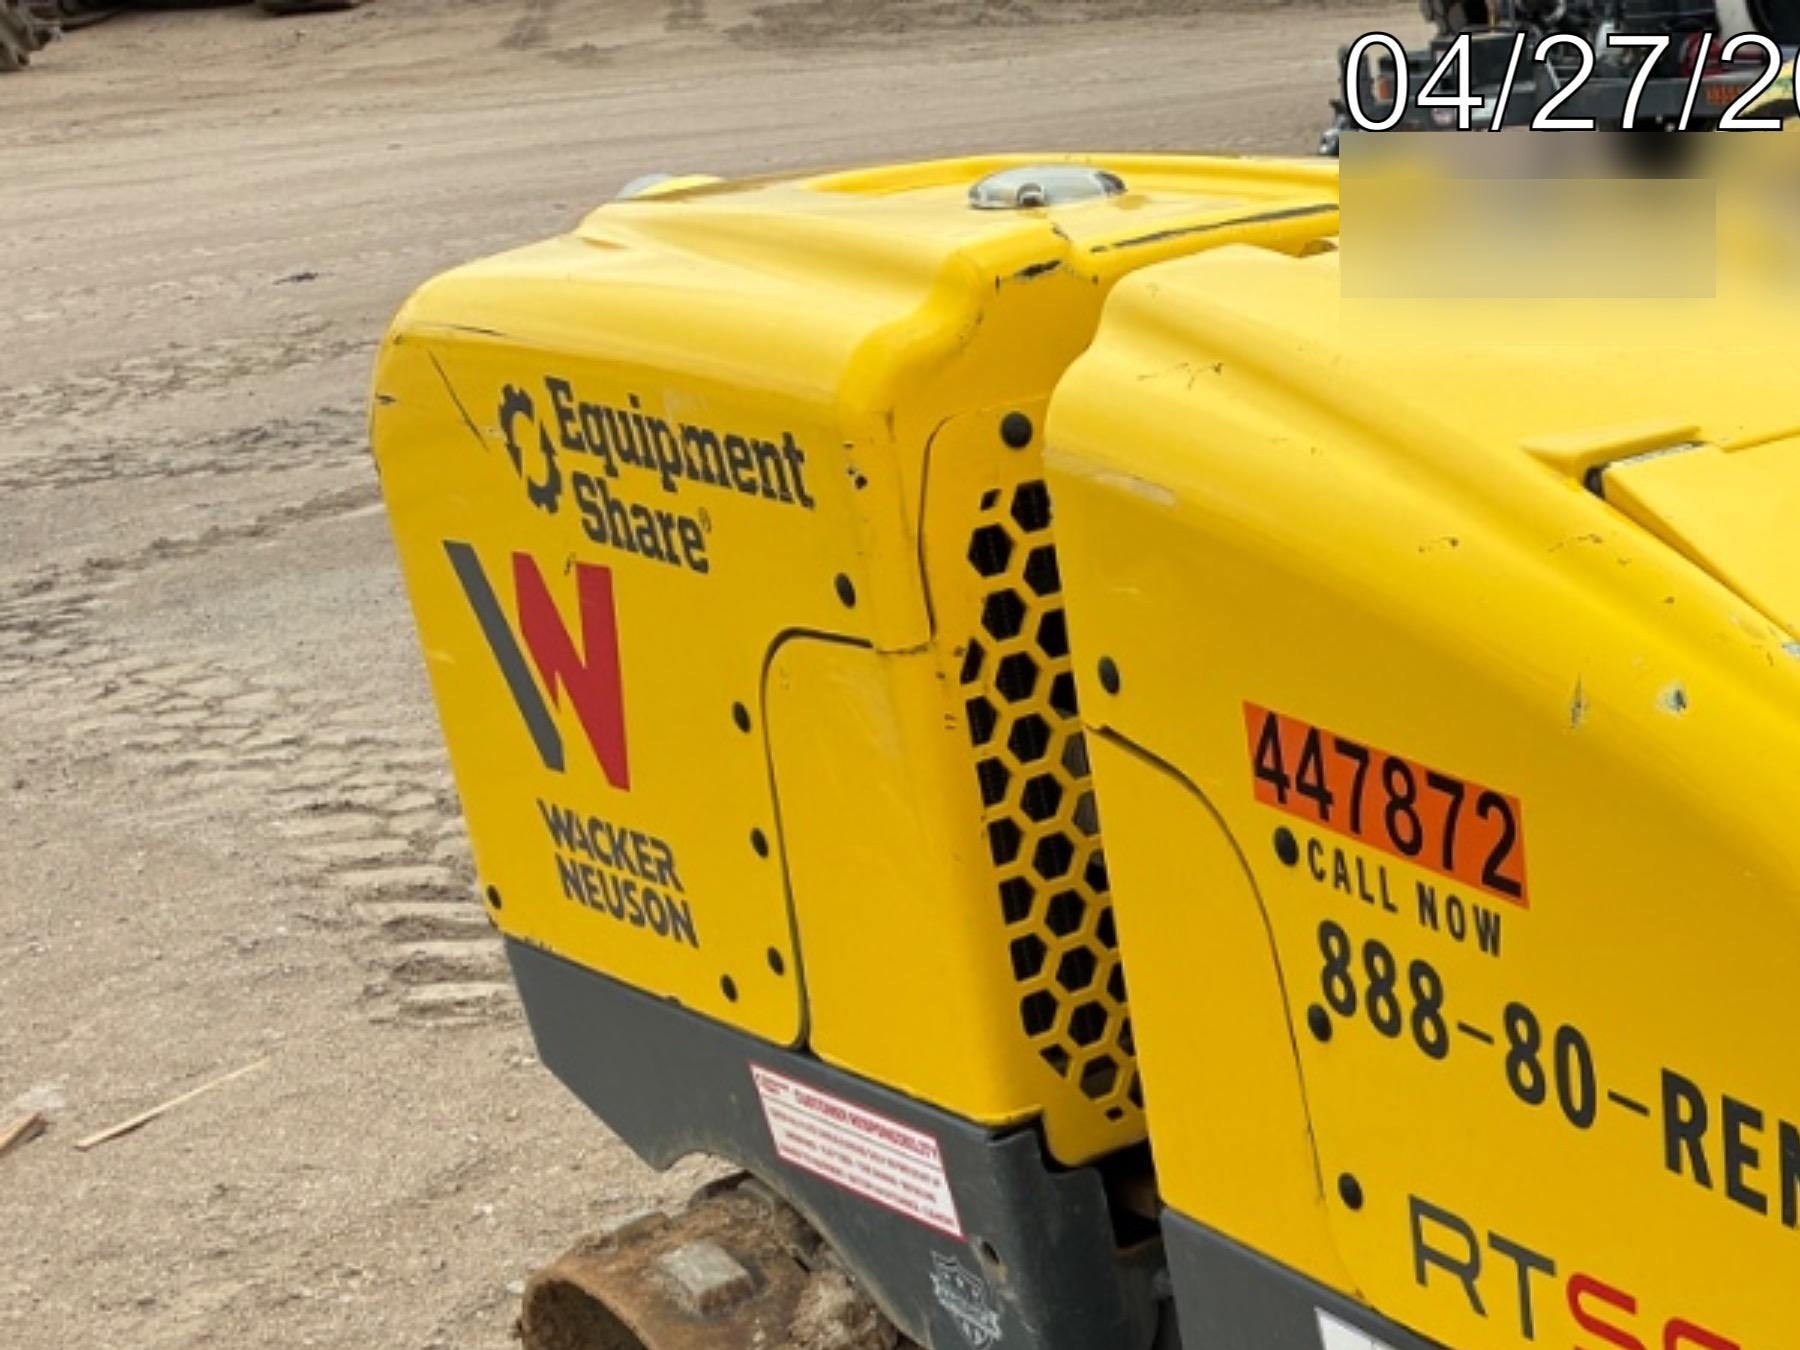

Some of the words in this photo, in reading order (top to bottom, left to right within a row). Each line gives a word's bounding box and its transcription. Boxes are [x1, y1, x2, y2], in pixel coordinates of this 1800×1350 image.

[545, 375, 817, 510] Equipment
[536, 798, 684, 892] WACKER
[1254, 711, 1522, 899] 447872
[555, 854, 700, 948] NEUSON
[1307, 837, 1398, 914] CALL
[1416, 880, 1501, 958] NOW
